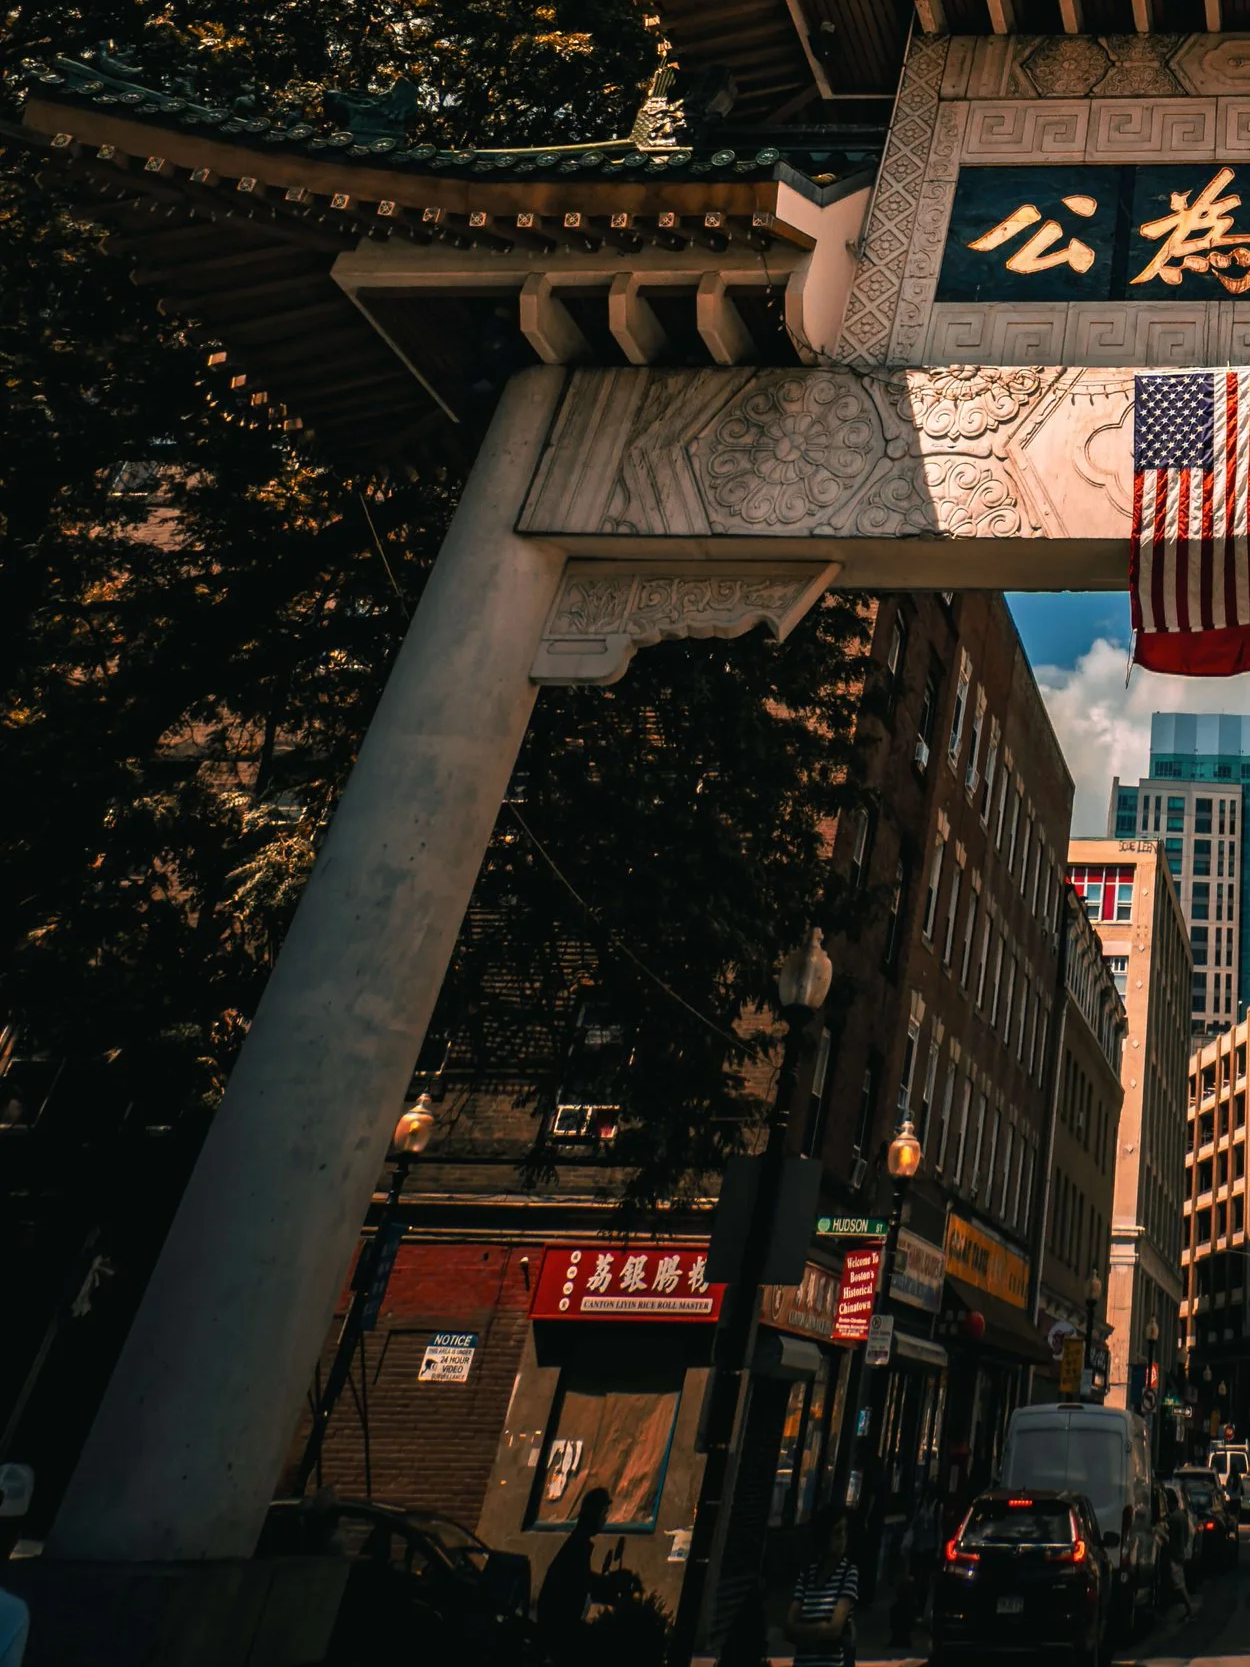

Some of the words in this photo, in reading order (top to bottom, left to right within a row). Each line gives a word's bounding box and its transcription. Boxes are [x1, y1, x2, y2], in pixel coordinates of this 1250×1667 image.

[833, 1218, 869, 1233] HUDSON
[876, 1224, 883, 1233] ST
[847, 1256, 871, 1269] Welcome
[872, 1252, 879, 1264] To
[843, 1282, 873, 1299] Historical
[584, 1300, 614, 1309] CANTON
[638, 1301, 656, 1310] RICE
[657, 1301, 678, 1310] ROLL
[678, 1301, 710, 1311] MASTER
[838, 1300, 872, 1315] Chinatown
[433, 1334, 473, 1347] NOTICE
[440, 1355, 448, 1363] 24
[449, 1356, 470, 1364] HOUR
[442, 1364, 464, 1374] VIDEO
